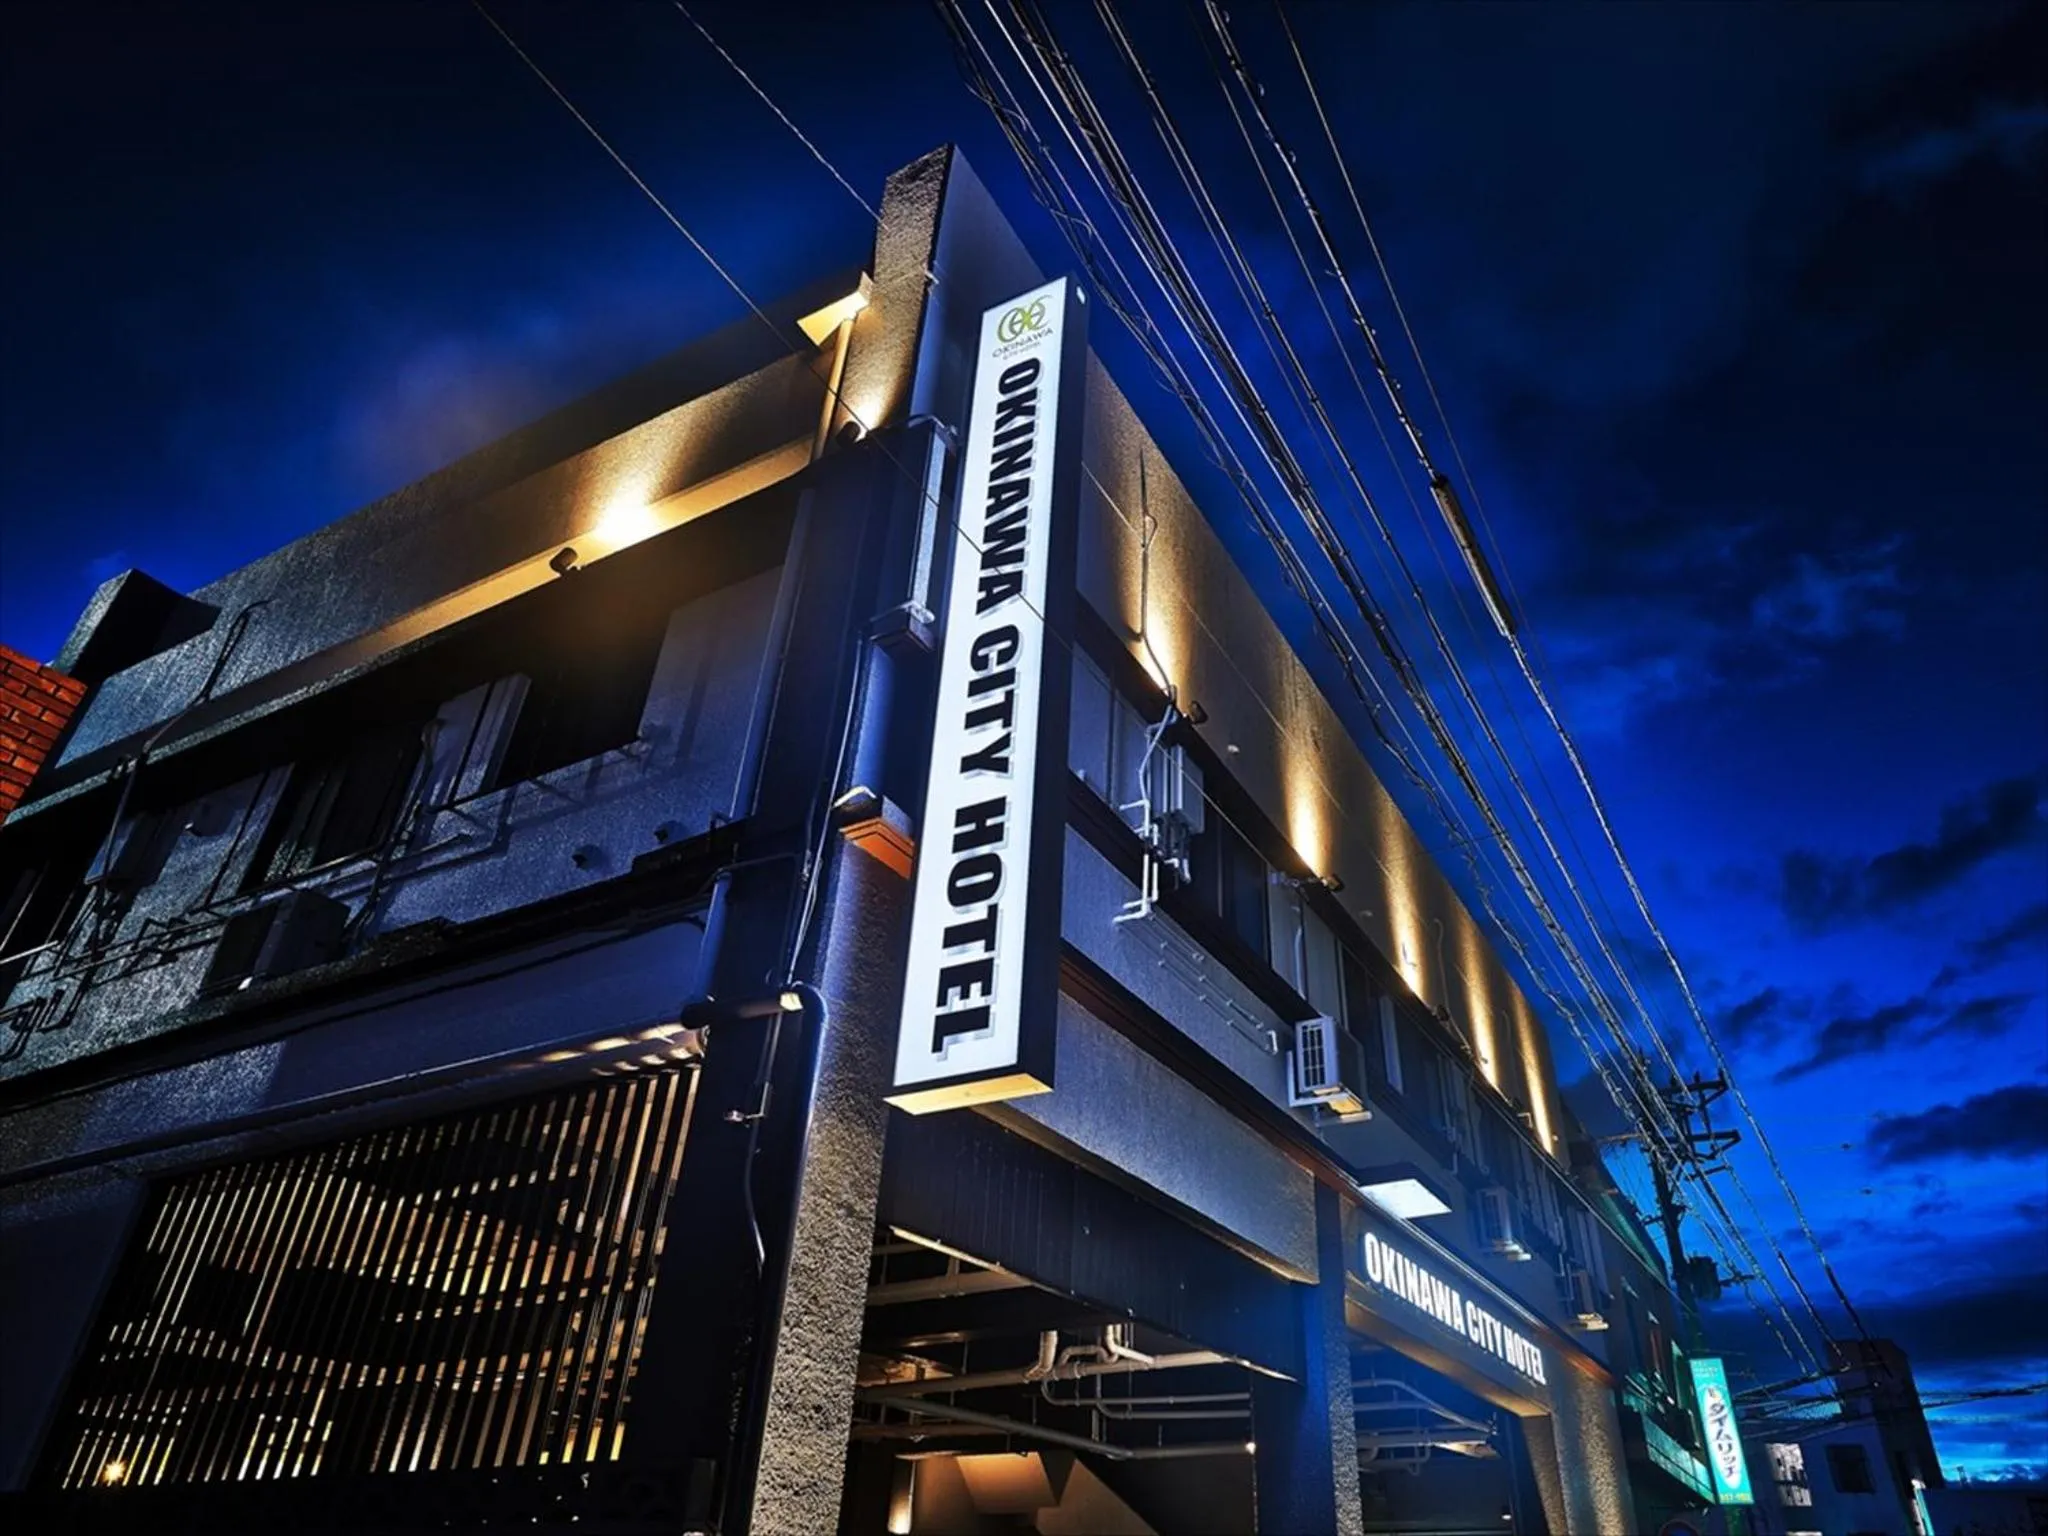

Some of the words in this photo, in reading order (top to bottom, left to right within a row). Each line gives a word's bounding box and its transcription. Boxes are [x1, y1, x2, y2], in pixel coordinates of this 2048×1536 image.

[992, 328, 1054, 358] OKINAWA
[976, 358, 1041, 614] OKINAWA
[961, 624, 1019, 774] CITY
[932, 796, 1007, 1054] HOTEL
[1364, 1232, 1467, 1336] OKINAWA
[1465, 1300, 1503, 1359] CITY
[1503, 1325, 1546, 1385] HOTEL
